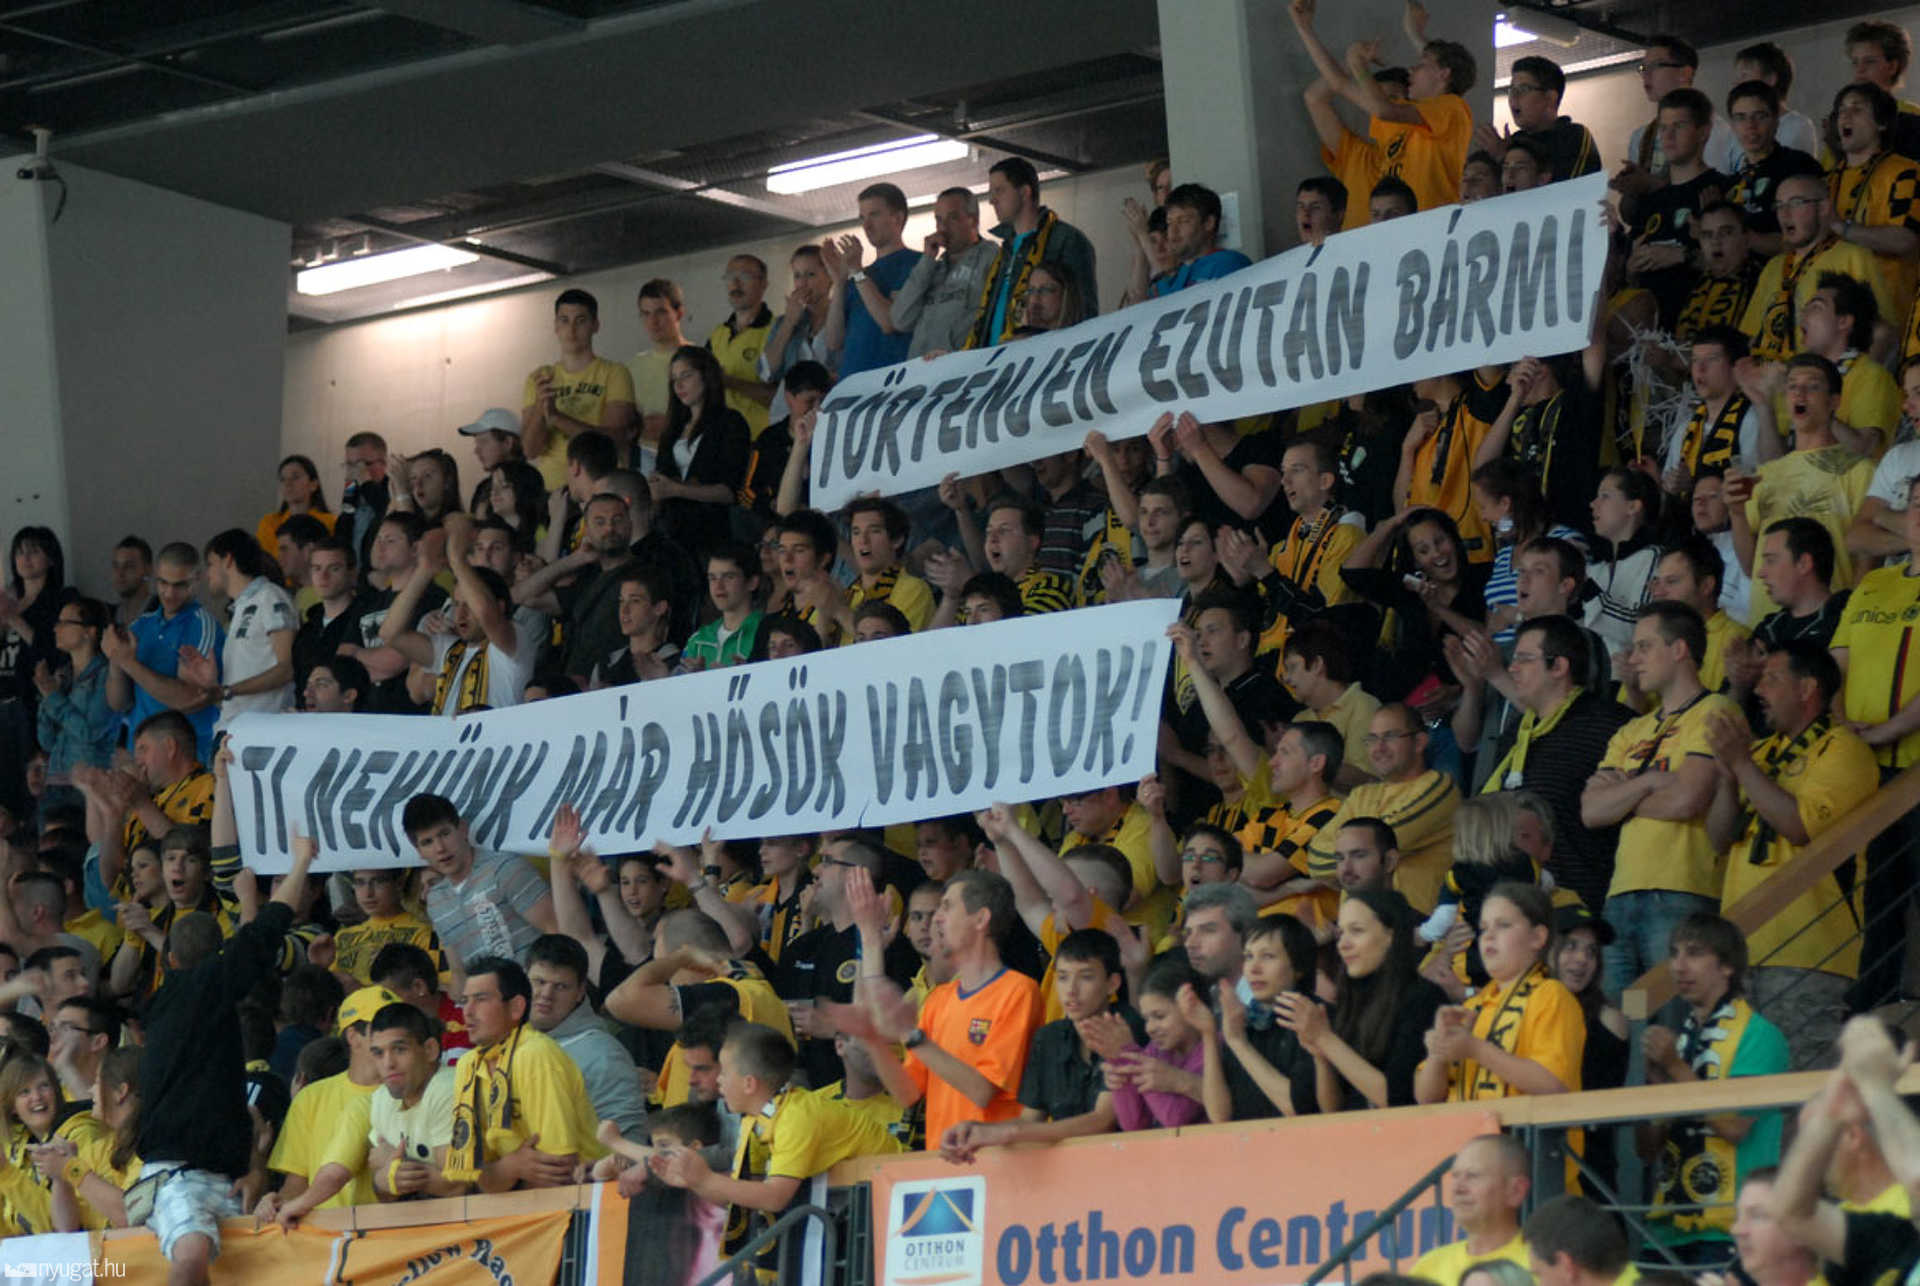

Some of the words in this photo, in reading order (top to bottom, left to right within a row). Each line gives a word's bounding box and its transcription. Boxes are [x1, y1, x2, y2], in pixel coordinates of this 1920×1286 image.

[820, 325, 1133, 489] TÖRTÉNJEN
[1138, 244, 1371, 403] EZUTÁN
[1393, 208, 1586, 361] BÁRMI
[241, 746, 298, 855] TI
[303, 722, 549, 858] NEKÜNK
[528, 695, 671, 841] MÁR
[672, 665, 848, 830] HŐSÖK
[866, 640, 1157, 805] VAGYTOK!
[905, 1239, 966, 1256] OTTHON
[996, 1210, 1196, 1286] Otthon
